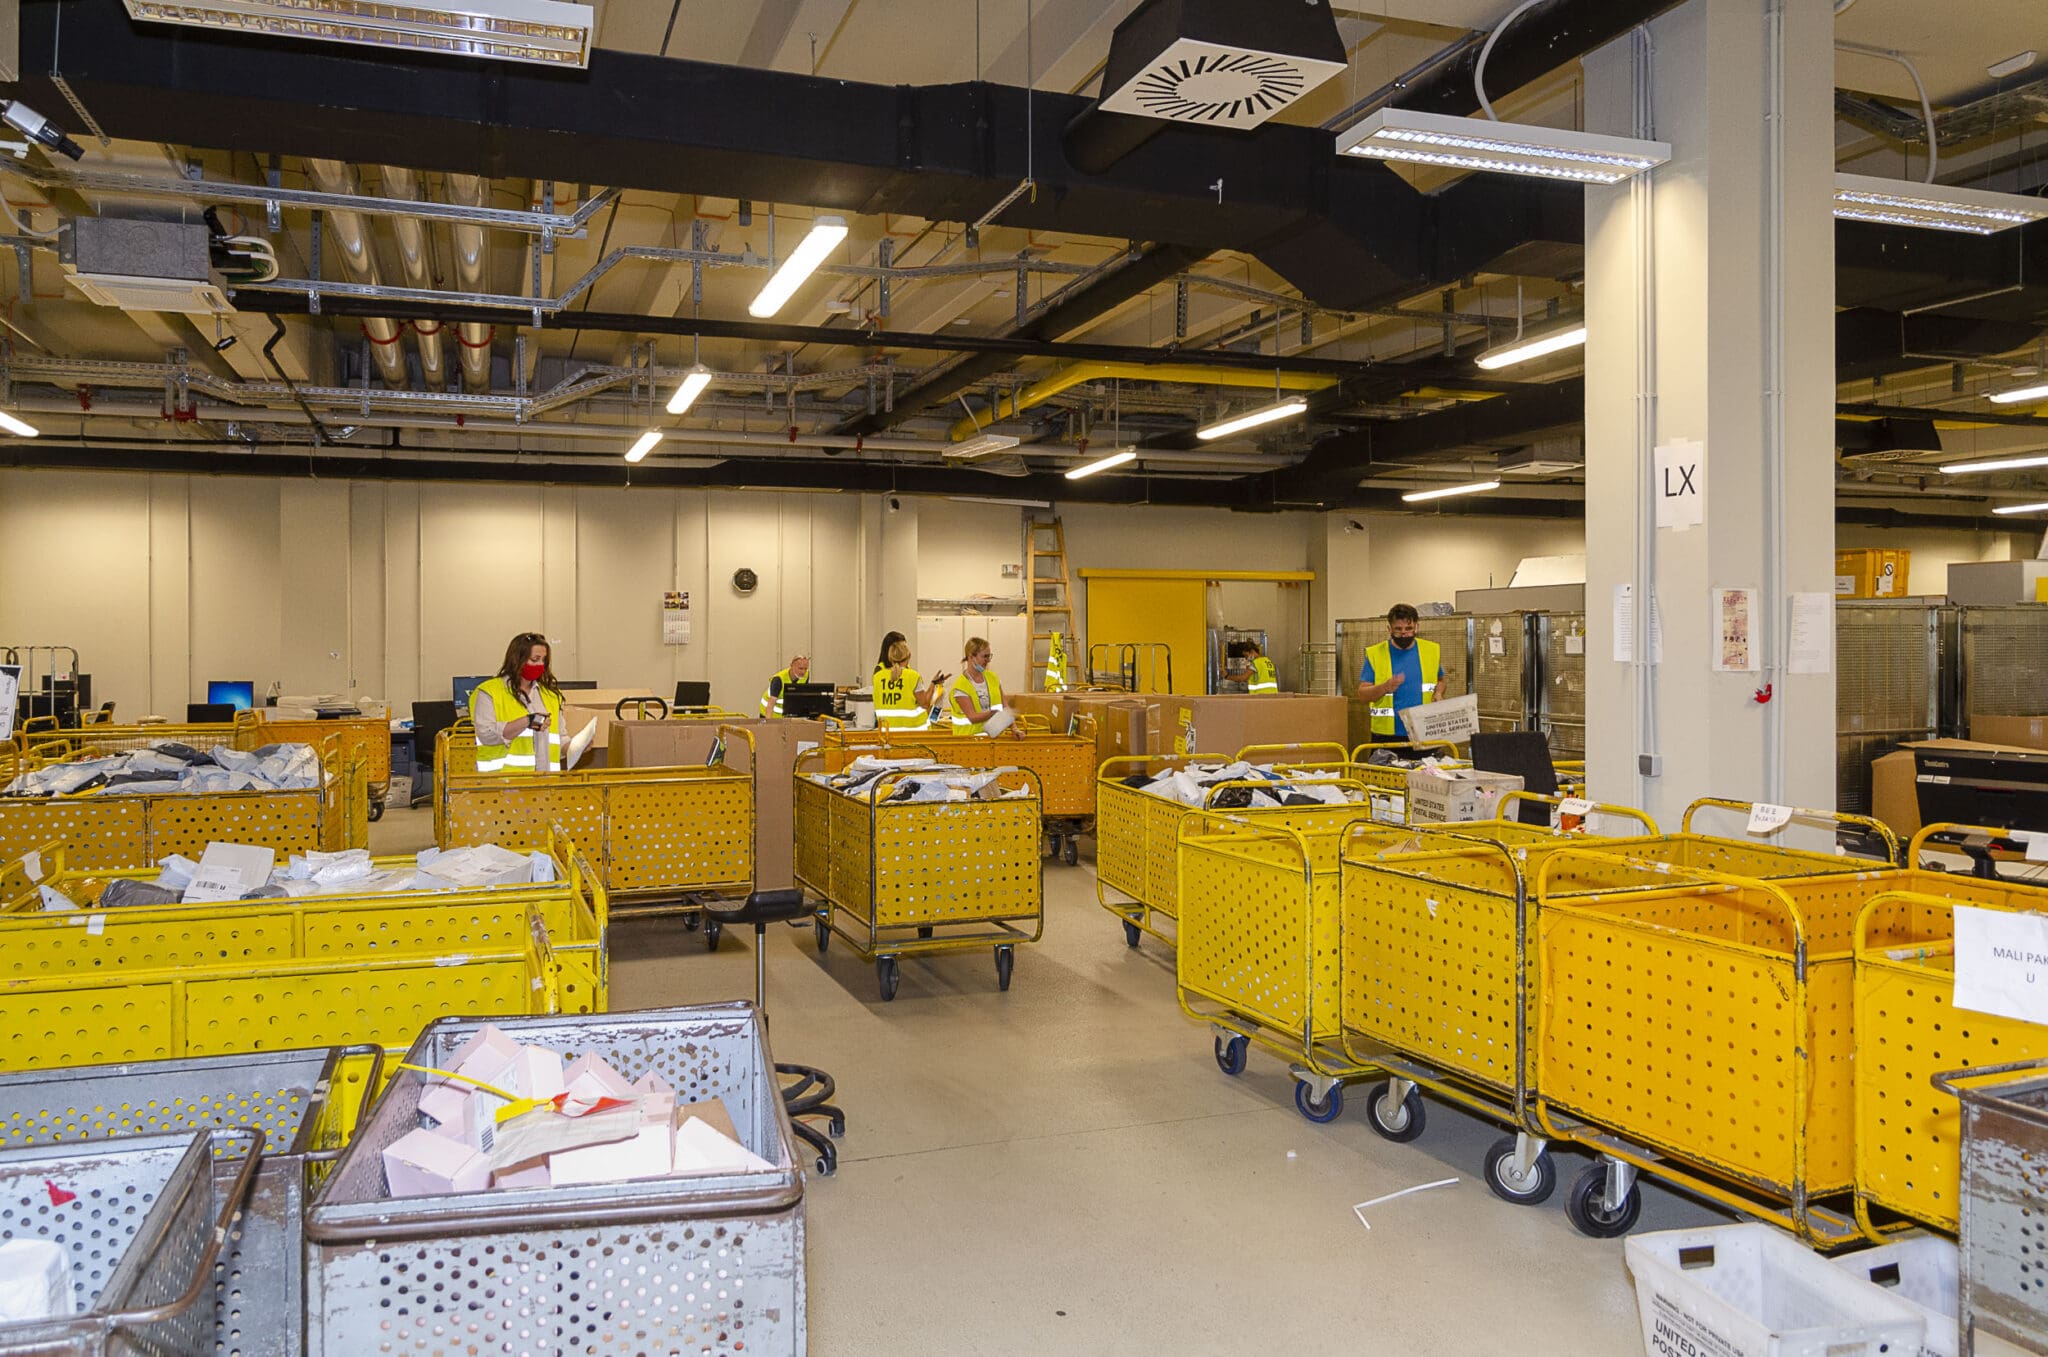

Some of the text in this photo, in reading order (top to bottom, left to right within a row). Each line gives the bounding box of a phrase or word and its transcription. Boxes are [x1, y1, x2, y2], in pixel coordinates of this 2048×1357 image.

[1665, 464, 1696, 497] LX
[881, 678, 904, 690] 164
[882, 692, 902, 705] MP
[1415, 798, 1445, 812] UNITED STATES
[1413, 806, 1447, 823] POSTAL SERVICE
[1993, 946, 2023, 961] MALI
[2026, 972, 2035, 984] U
[1655, 1318, 1696, 1357] UNITED
